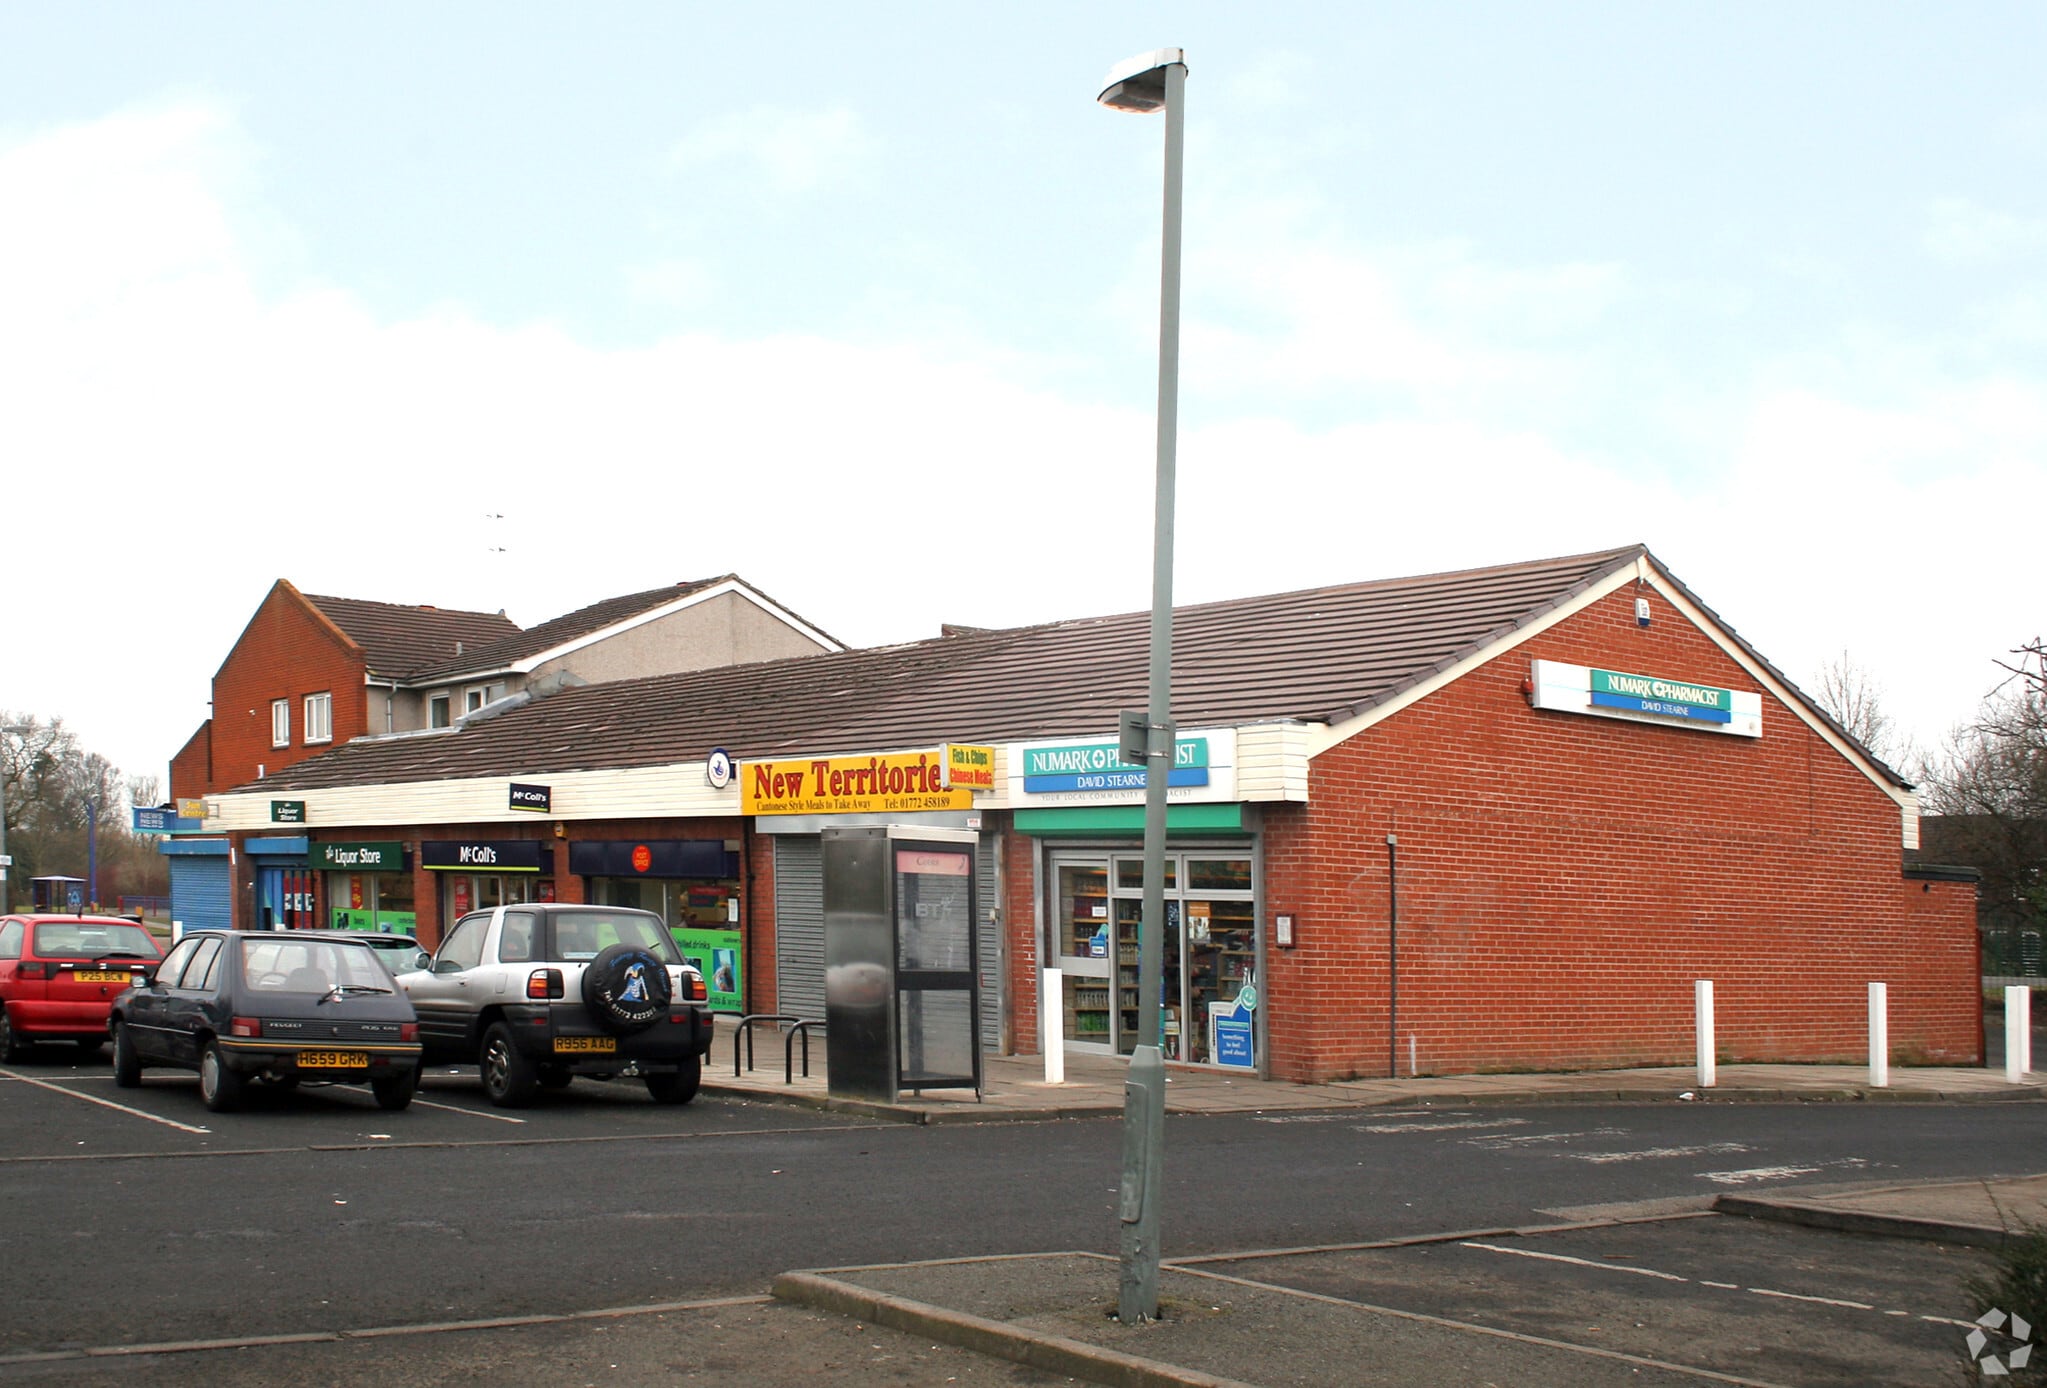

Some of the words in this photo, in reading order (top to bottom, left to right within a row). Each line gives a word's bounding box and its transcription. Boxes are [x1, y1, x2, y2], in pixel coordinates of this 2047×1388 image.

[1608, 675, 1652, 698] NUMARK
[1662, 683, 1719, 706] PHARMACIST
[1642, 701, 1661, 712] DAVID
[1662, 704, 1689, 716] STEARNE
[953, 748, 964, 764] Fish
[966, 751, 970, 764] &
[971, 749, 987, 766] Chips
[1032, 751, 1091, 773] NUMARK
[754, 764, 803, 799] New
[950, 768, 973, 784] Chinese
[975, 769, 992, 785] Meals
[1077, 776, 1105, 788] DAVID
[1107, 774, 1146, 787] STEARNE
[513, 791, 546, 802] McColl's
[1089, 791, 1138, 799] COMMUNITY
[757, 801, 787, 811] Cantonese
[789, 800, 804, 812] Style
[806, 800, 824, 809] Meals
[826, 800, 832, 809] to
[834, 799, 850, 809] Take
[853, 798, 870, 810] Away
[885, 798, 899, 809] Tel:
[900, 798, 922, 808] 01772
[924, 797, 950, 808] 458189
[335, 848, 357, 867] Liquor
[360, 848, 381, 864] Store
[460, 846, 496, 863] McColl's
[556, 1038, 588, 1049] R956
[300, 1053, 336, 1065] H659
[340, 1053, 366, 1065] GRK
